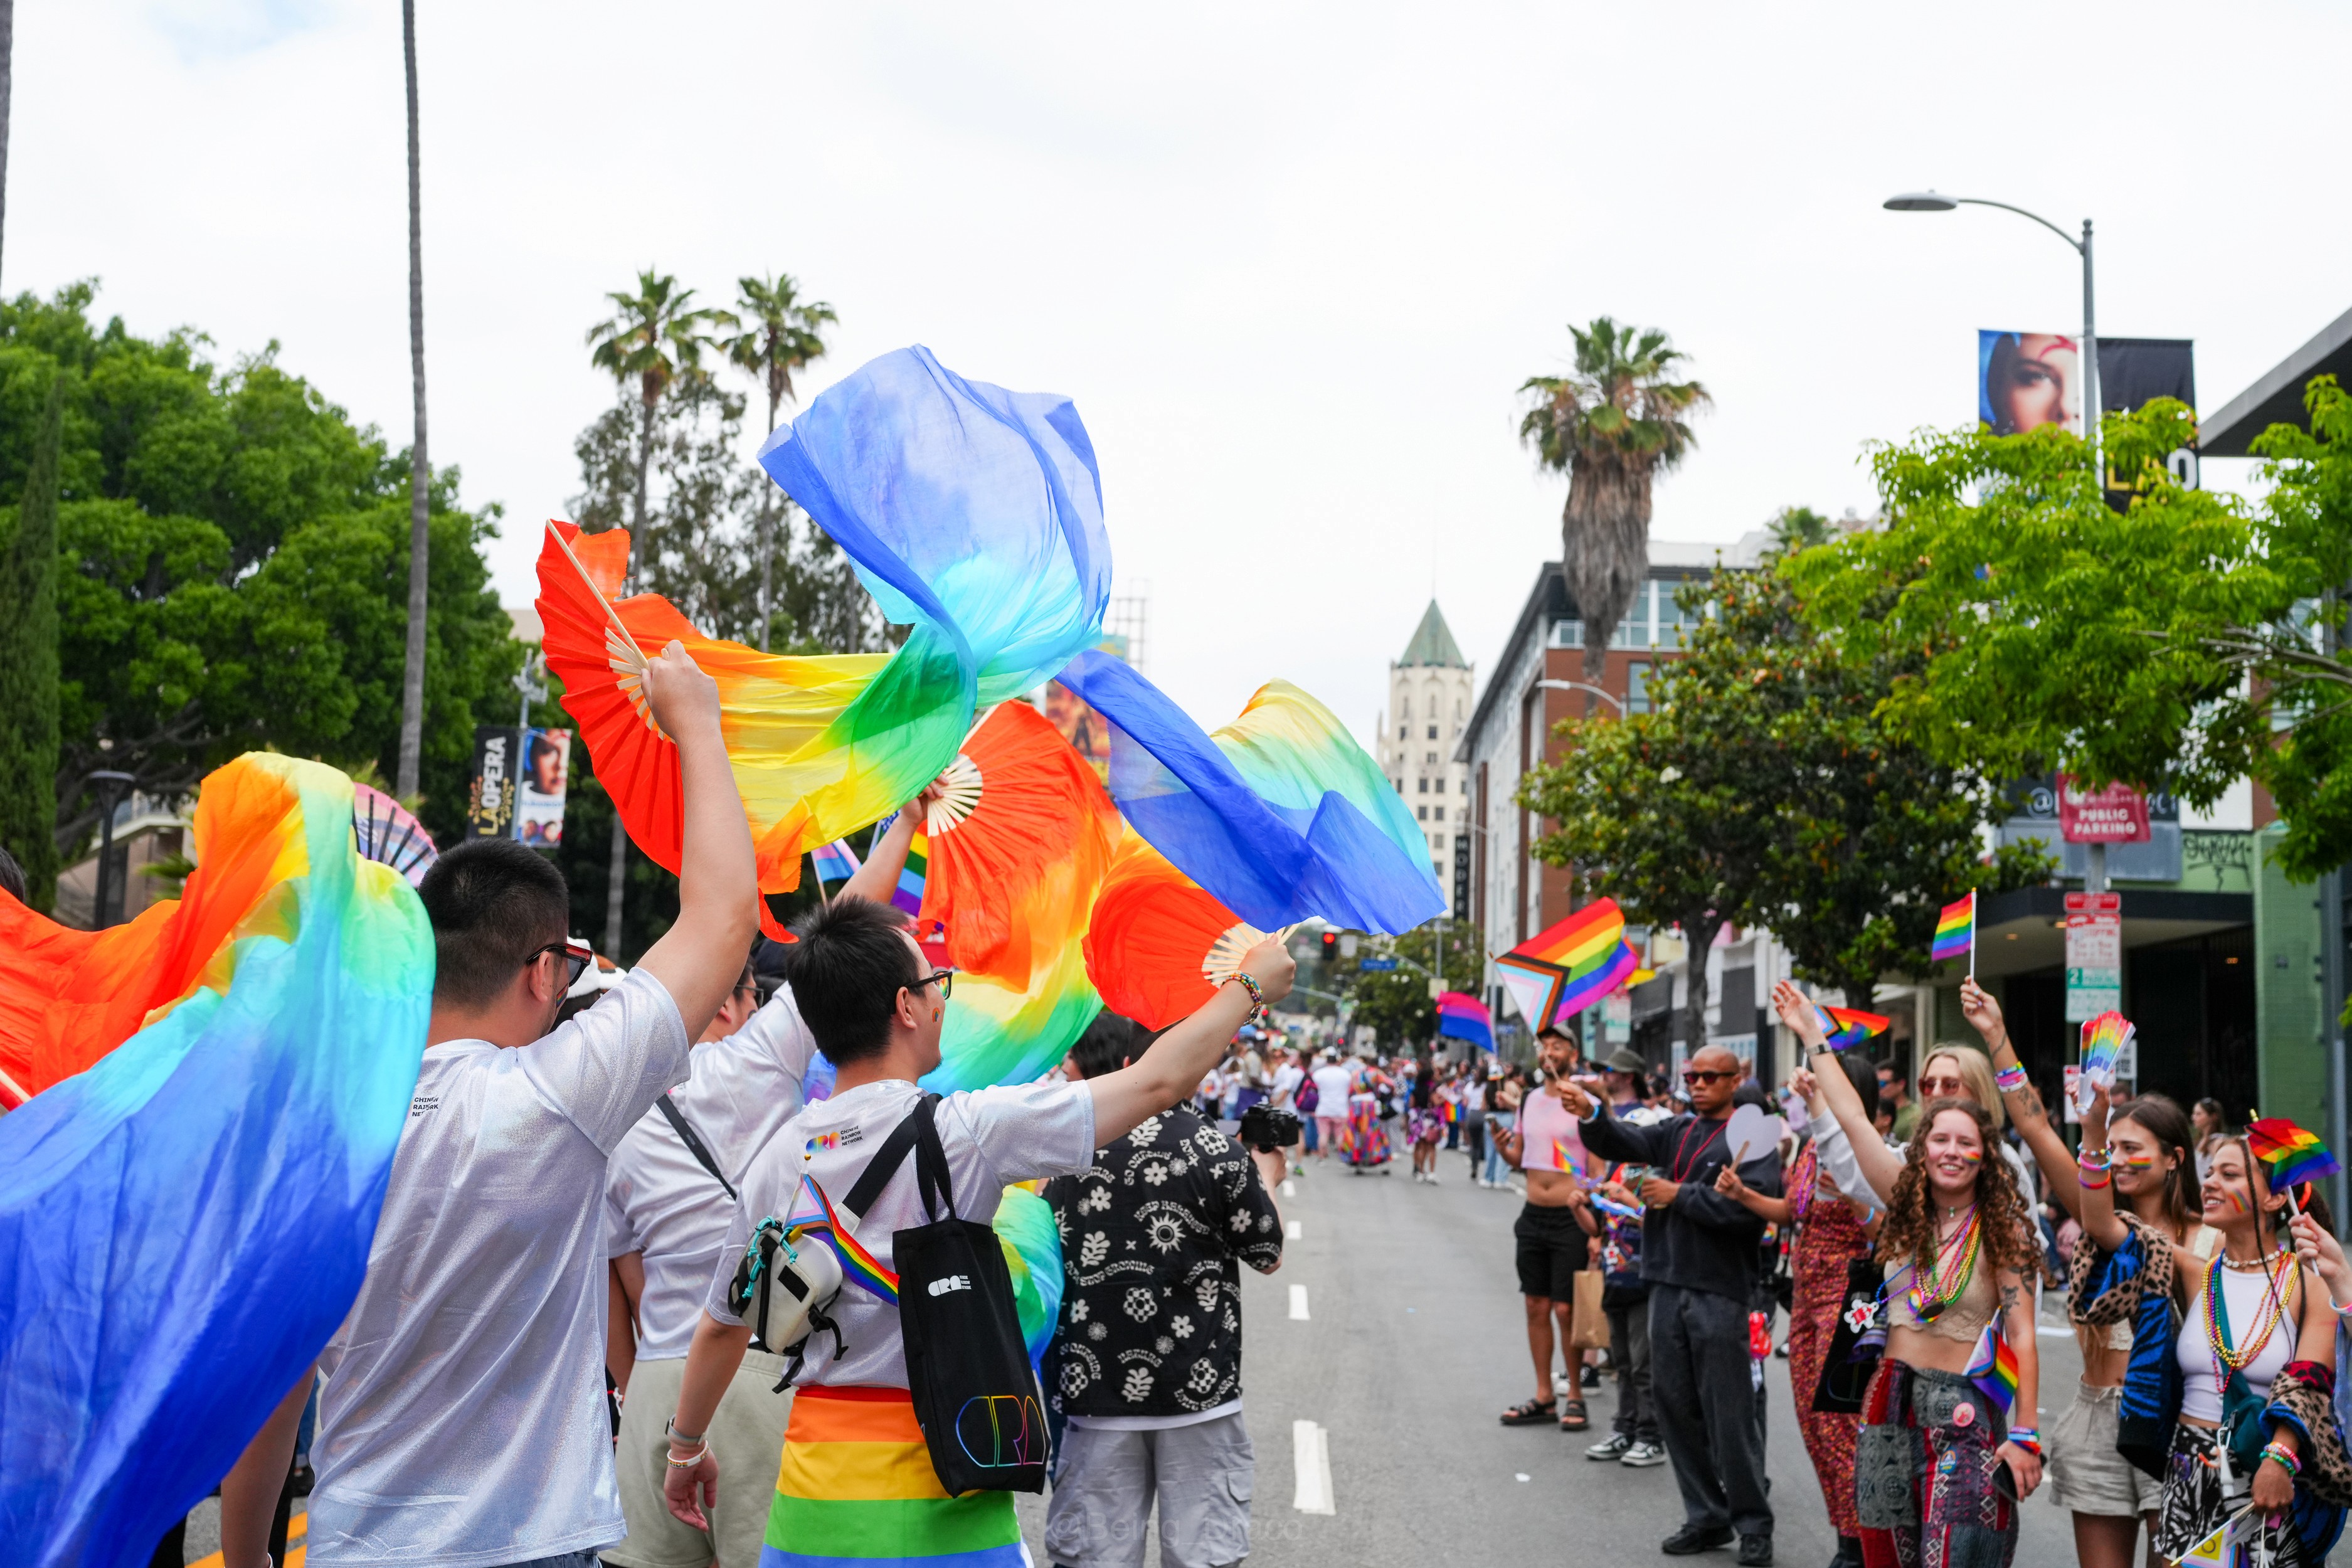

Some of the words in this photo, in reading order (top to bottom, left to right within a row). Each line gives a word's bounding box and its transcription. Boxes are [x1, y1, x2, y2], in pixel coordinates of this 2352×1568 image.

[480, 736, 507, 808] OPERA
[2079, 808, 2129, 822] PUBLIC
[2074, 822, 2136, 835] PARKING
[840, 1125, 859, 1135] CHINESE
[841, 1130, 861, 1140] RAINBOW
[842, 1136, 863, 1147] NETWORK
